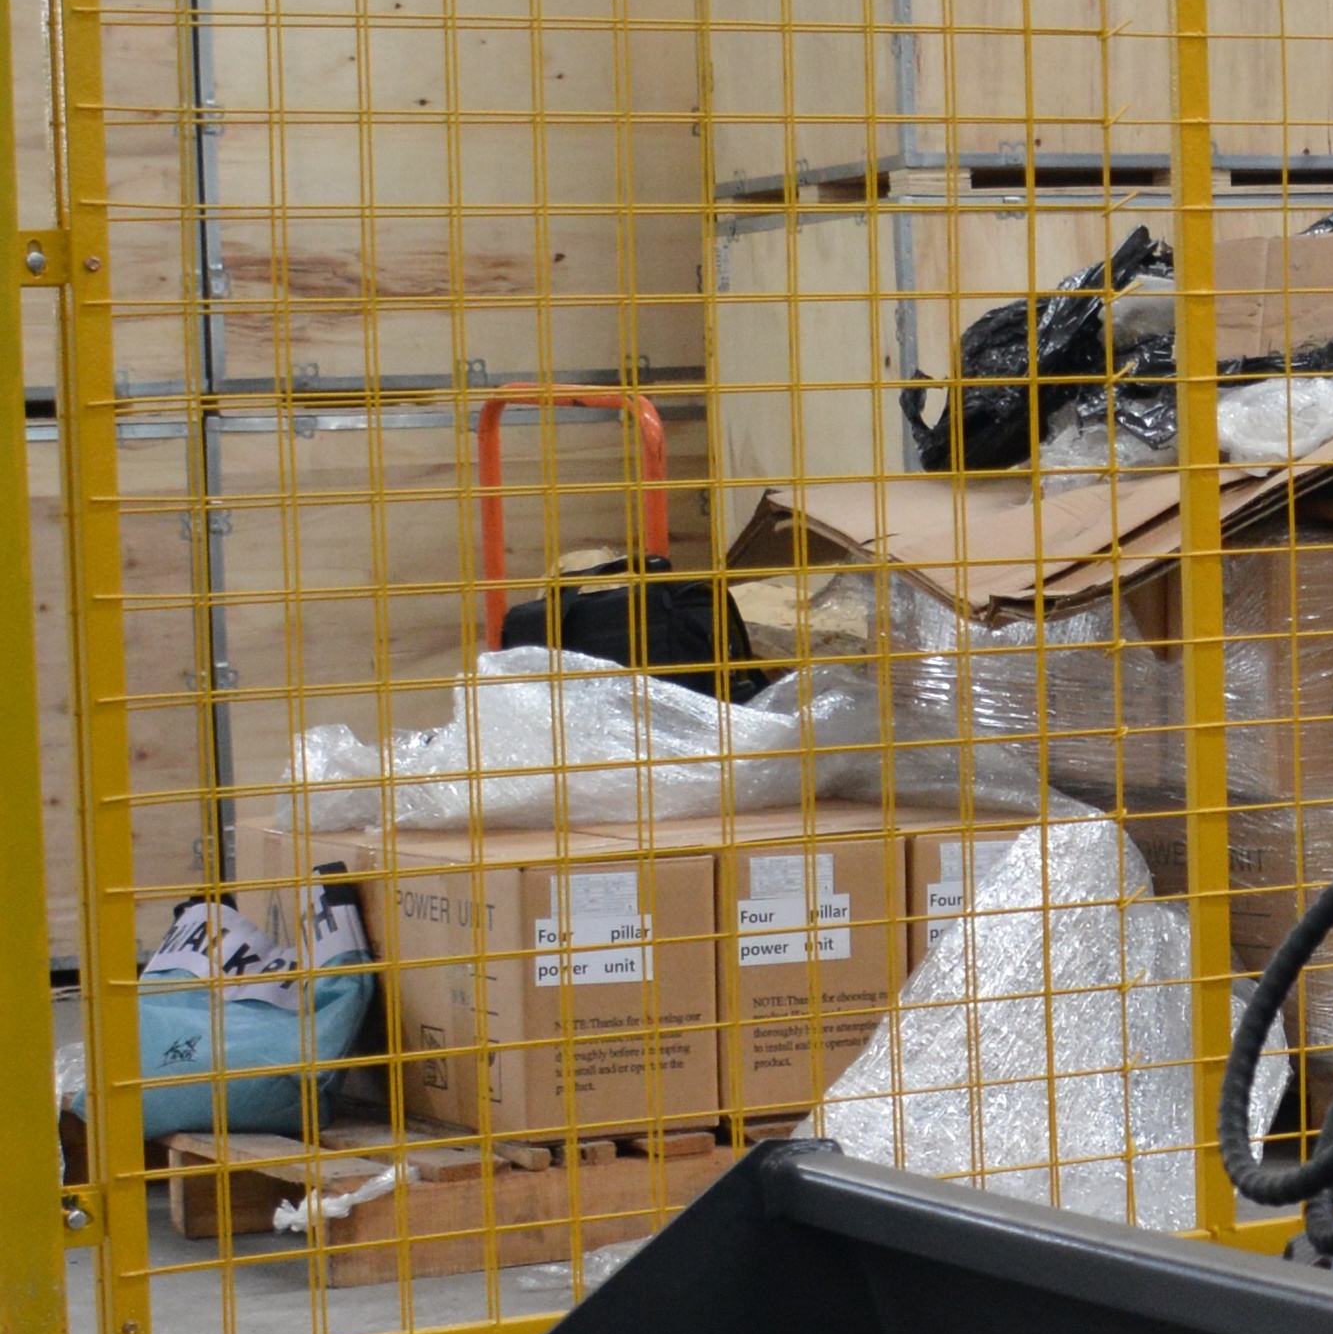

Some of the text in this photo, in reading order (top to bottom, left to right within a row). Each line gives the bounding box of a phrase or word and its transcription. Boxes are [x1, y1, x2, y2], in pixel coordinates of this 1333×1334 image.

[930, 893, 963, 907] Four
[740, 910, 775, 924] Four
[741, 943, 789, 961] power
[604, 958, 636, 973] unit
